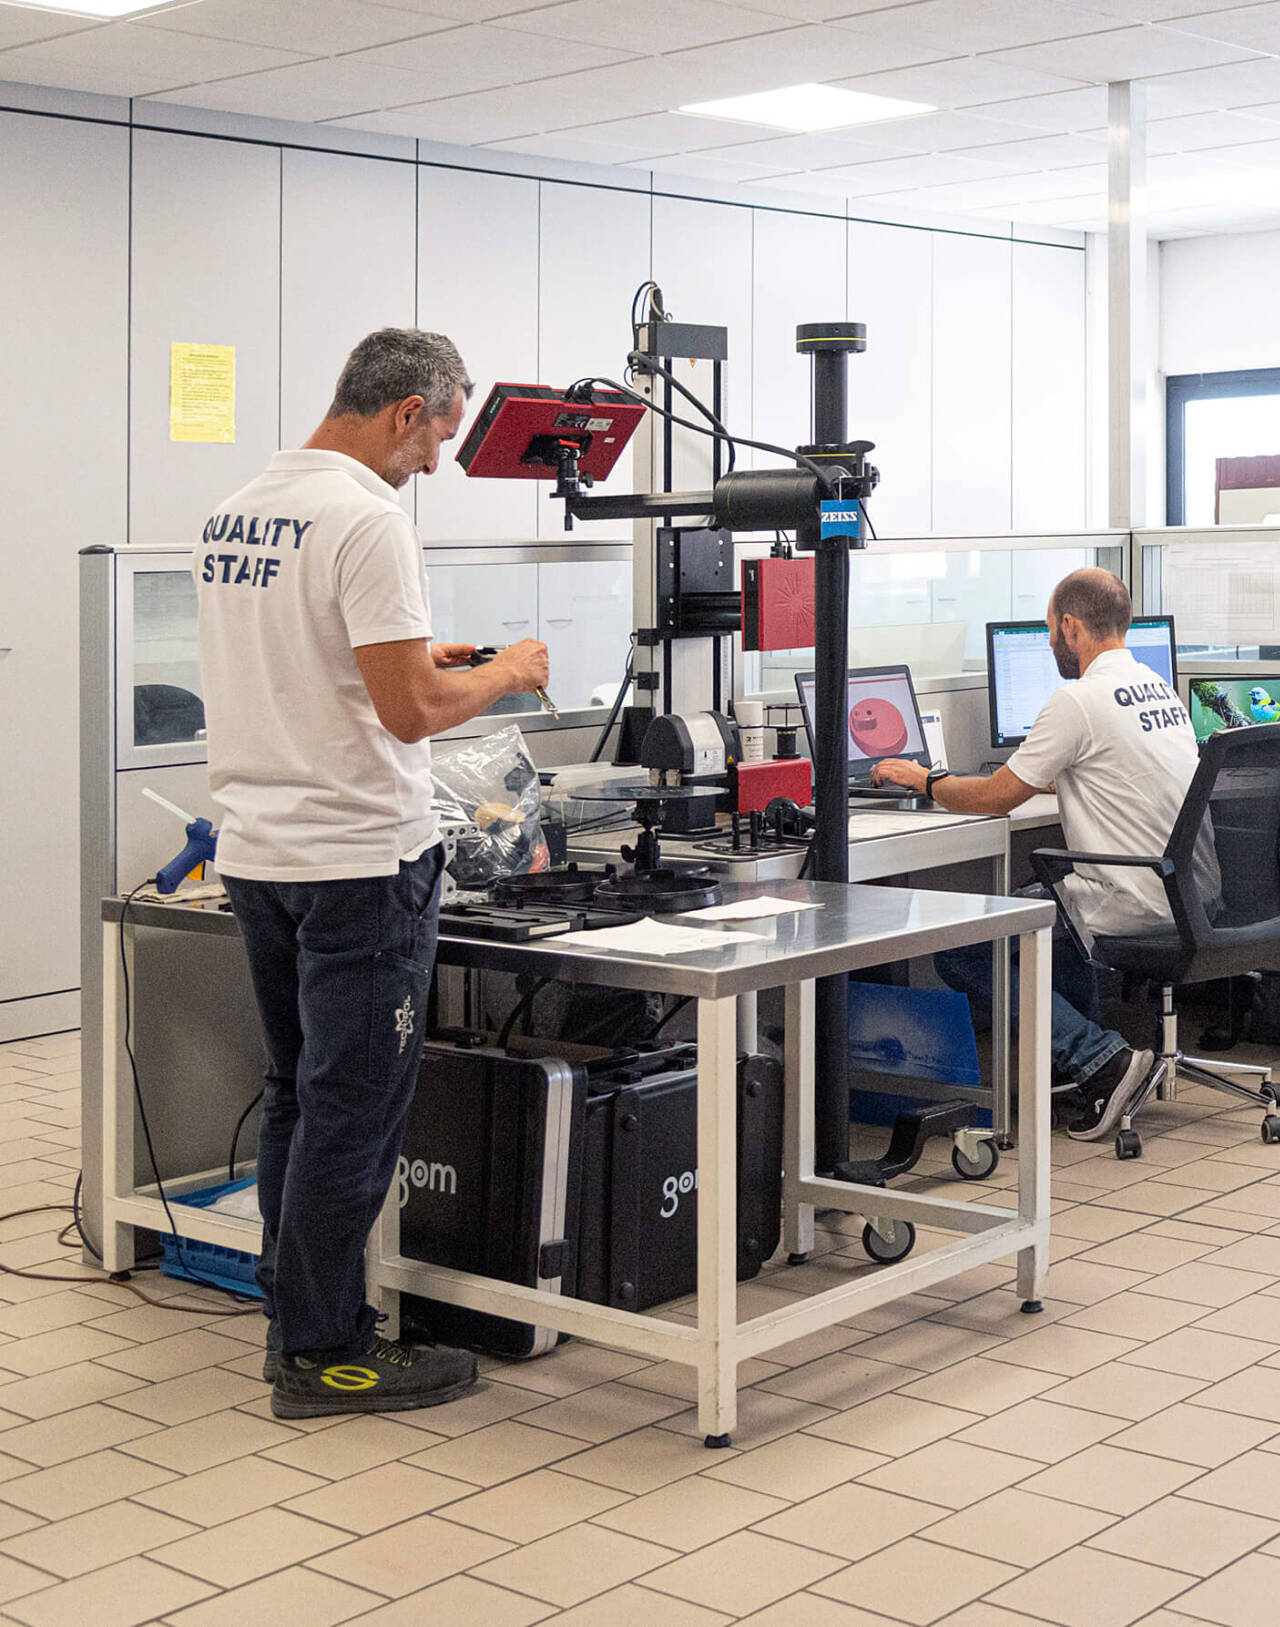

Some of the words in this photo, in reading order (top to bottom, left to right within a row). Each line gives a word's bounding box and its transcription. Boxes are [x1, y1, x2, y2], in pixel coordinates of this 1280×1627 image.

[203, 514, 313, 549] QUALITY
[821, 511, 858, 522] ZEISS
[202, 554, 281, 587] STAFF
[1139, 706, 1187, 732] STAFF
[660, 1169, 698, 1218] go
